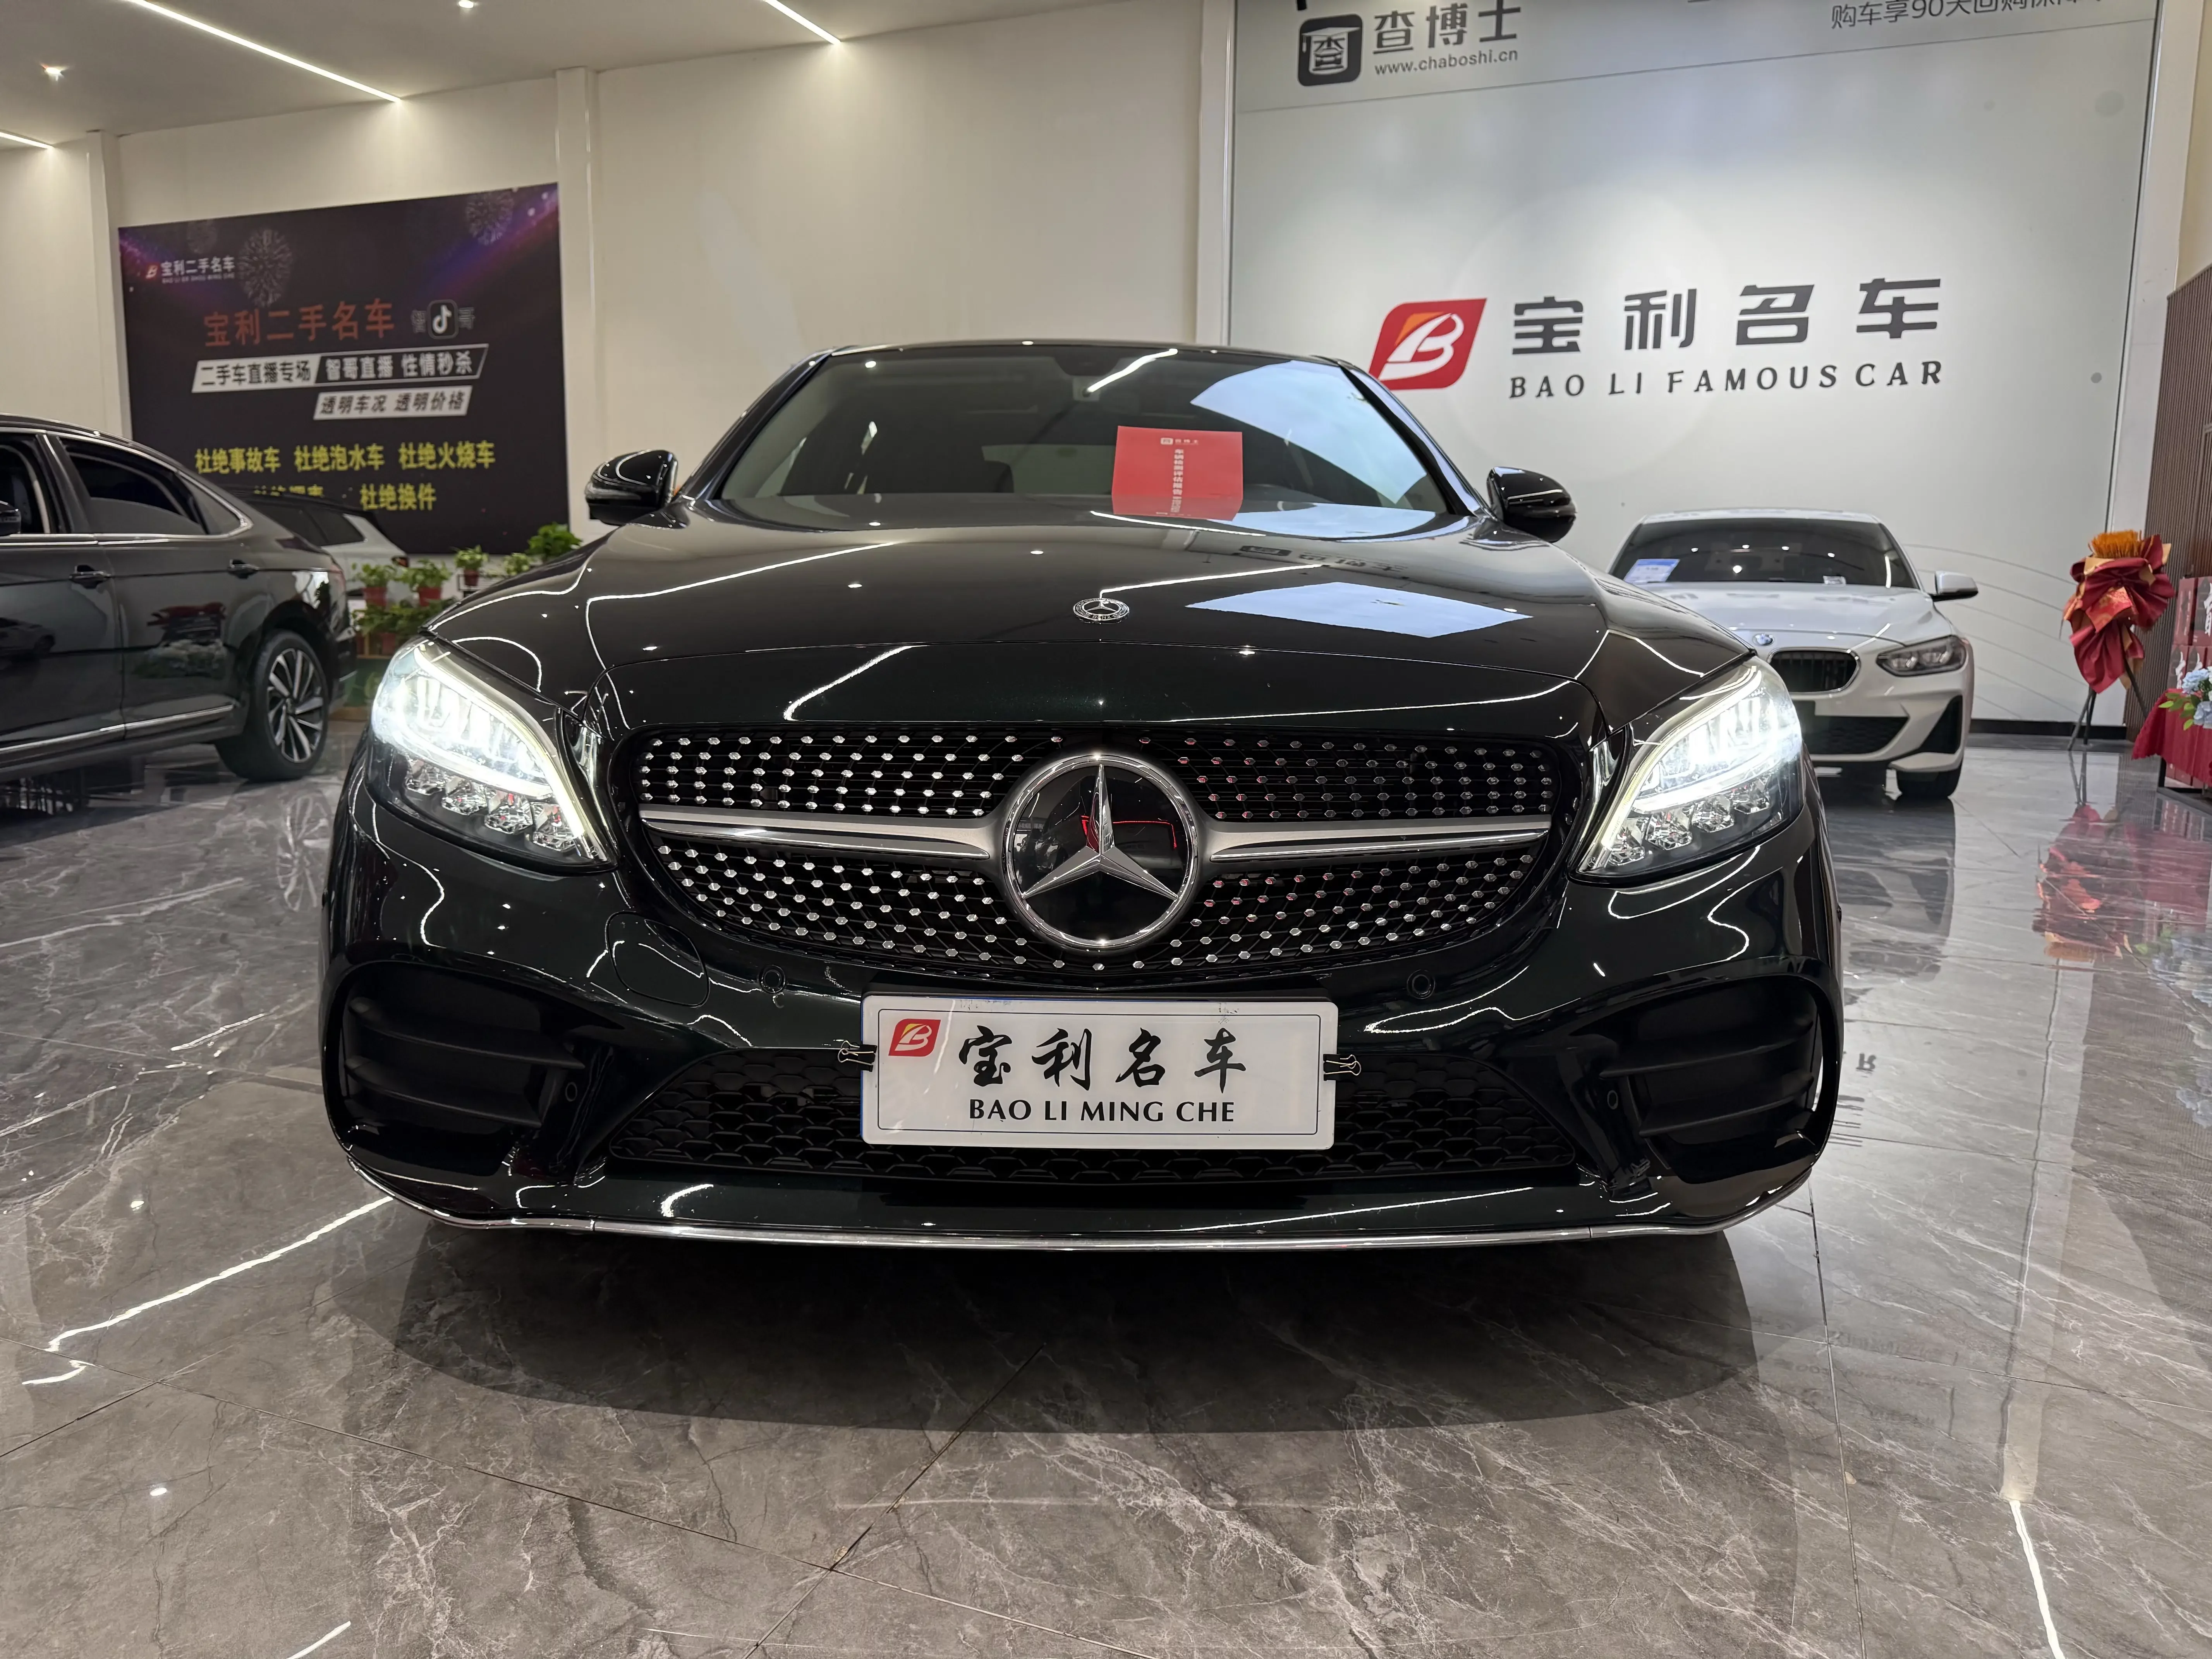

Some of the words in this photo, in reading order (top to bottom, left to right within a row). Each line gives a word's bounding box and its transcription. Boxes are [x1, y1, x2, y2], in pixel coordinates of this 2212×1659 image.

[1373, 0, 1521, 54] 查博士
[1374, 49, 1518, 75] www.chaboshi.cn
[160, 255, 235, 276] 宝利二手名车
[204, 298, 395, 347] 宝利二手名车
[1512, 278, 1941, 355] 宝利名车
[201, 360, 311, 385] 二手车直播专场
[1510, 374, 1584, 398] BAO
[1609, 372, 1642, 395] LI
[1668, 365, 1837, 393] FAMOUS
[1856, 361, 1941, 386] CAR
[320, 394, 387, 415] 透明车况
[394, 390, 465, 412] 透明价格
[195, 446, 281, 474] 杜绝事故车
[294, 443, 385, 472] 杜绝泡水车
[398, 440, 495, 470] 杜绝火烧车
[360, 483, 436, 510] 杜绝换件
[958, 1025, 1246, 1094] 宝利名车
[970, 1099, 1031, 1122] BAO
[1045, 1100, 1067, 1121] LI
[1080, 1101, 1163, 1123] MING
[1176, 1101, 1234, 1122] CHE
